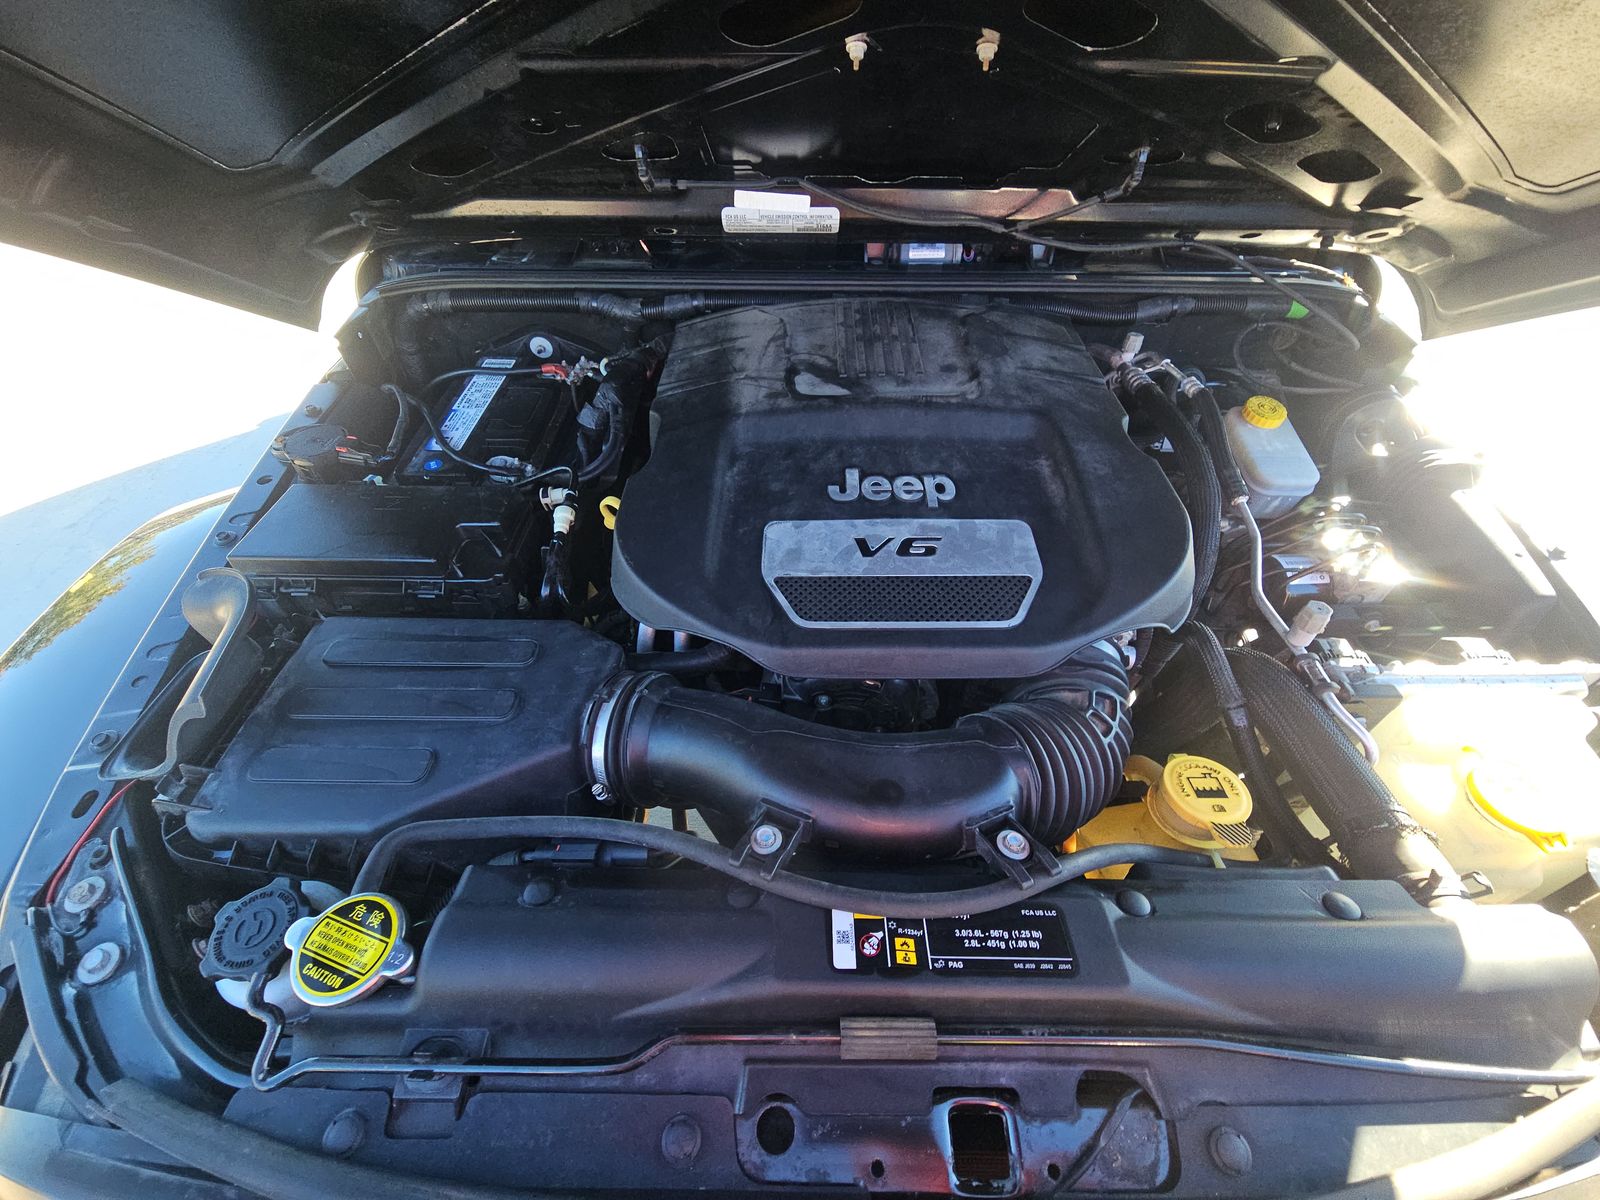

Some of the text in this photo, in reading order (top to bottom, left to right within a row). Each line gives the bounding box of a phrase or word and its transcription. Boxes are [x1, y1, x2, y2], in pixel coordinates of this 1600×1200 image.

[827, 468, 956, 508] Jeep
[854, 537, 942, 557] V6
[1223, 776, 1240, 796] ONLY
[348, 903, 385, 928] 危険
[318, 930, 333, 942] NEVER
[331, 936, 344, 946] OPEN
[343, 942, 358, 952] WHEN
[898, 928, 924, 936] R-1234yf
[954, 930, 984, 938] 3.0/3.6L
[990, 930, 1008, 939] 567g
[1012, 930, 1030, 940] (1.25
[1031, 930, 1042, 940] lb)
[316, 942, 334, 954] JAMAIS
[332, 950, 350, 962] OUVRIR
[986, 940, 1006, 949] 451g
[1008, 940, 1028, 950] (1.00
[1028, 940, 1040, 950] lb)
[302, 962, 344, 988] CAUTION
